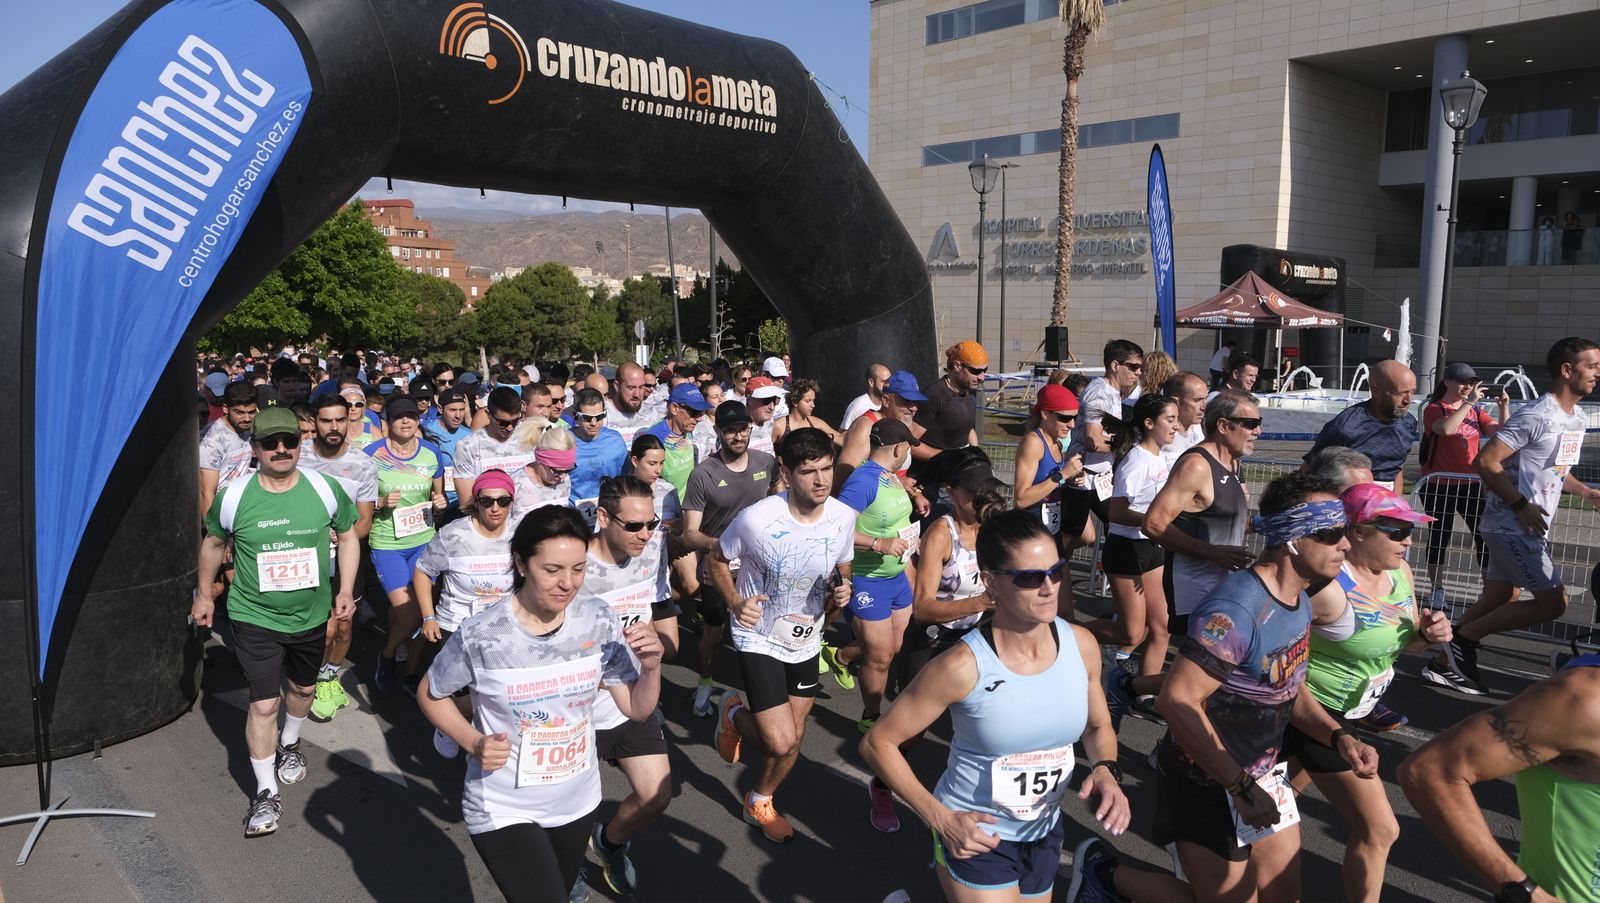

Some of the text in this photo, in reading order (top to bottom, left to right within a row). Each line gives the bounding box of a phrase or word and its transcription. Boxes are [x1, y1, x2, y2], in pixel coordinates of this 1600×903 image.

[537, 36, 778, 118] cruzandolameta
[621, 96, 778, 134] cronometraje deportivo
[178, 100, 303, 288] centrohogarsanchez.es
[262, 541, 294, 551] El Ejido
[266, 562, 310, 578] 1211
[791, 625, 814, 638] 99
[531, 735, 587, 766] 1064
[1013, 767, 1063, 796] 157
